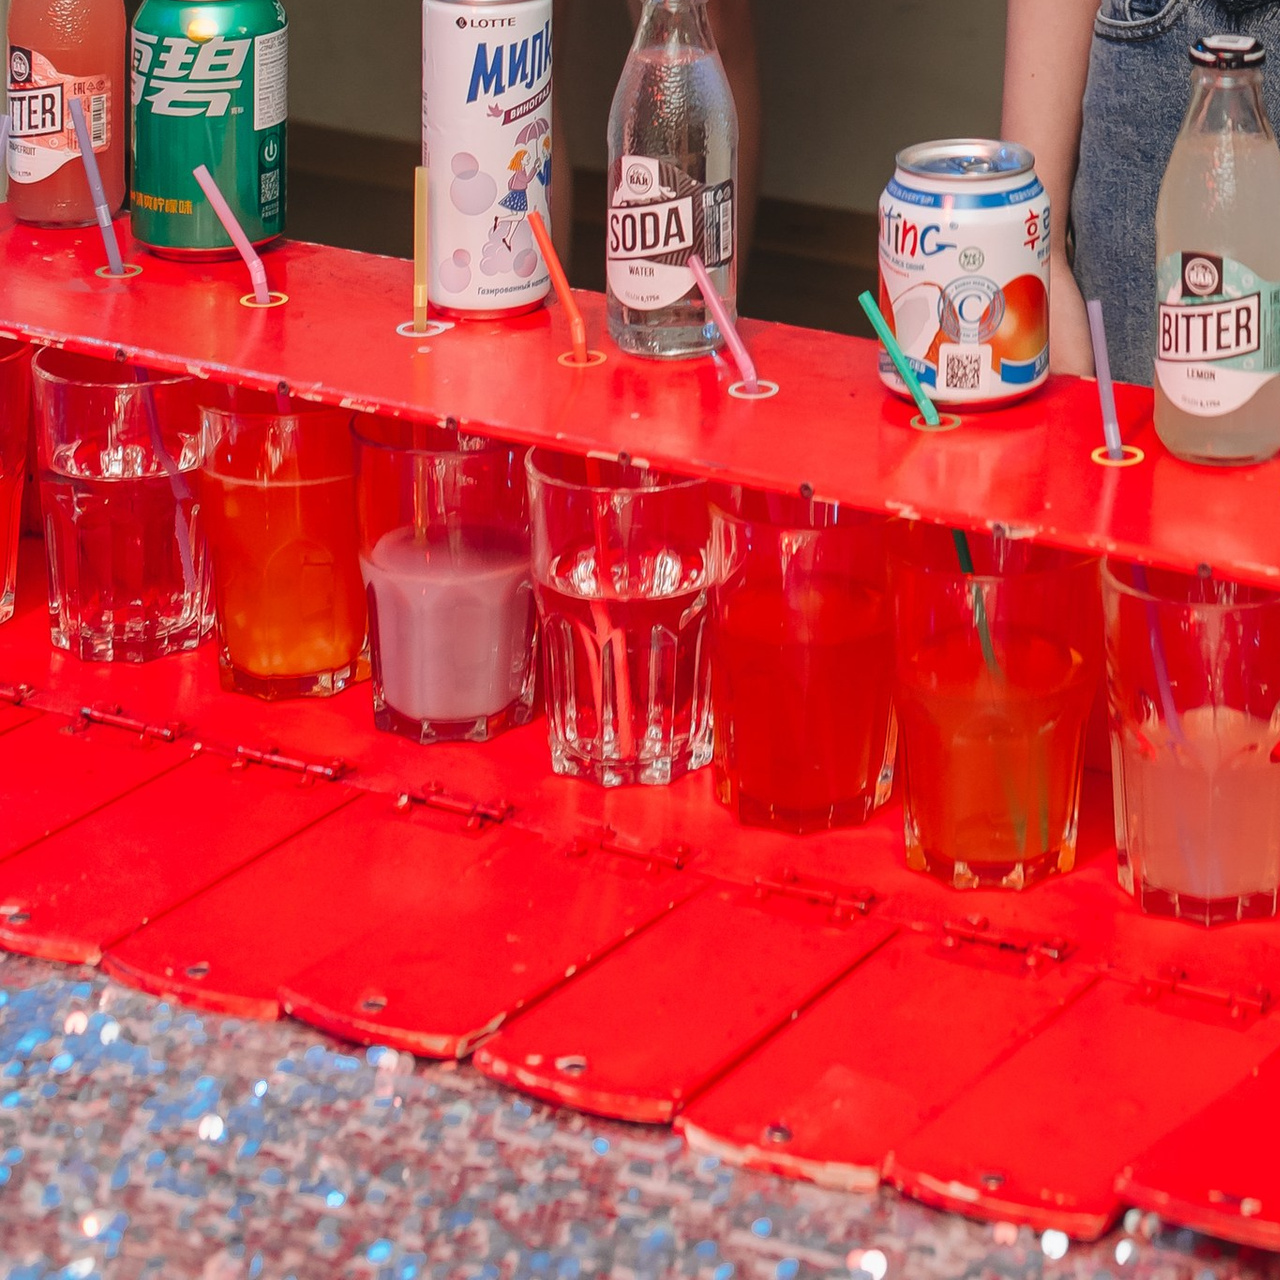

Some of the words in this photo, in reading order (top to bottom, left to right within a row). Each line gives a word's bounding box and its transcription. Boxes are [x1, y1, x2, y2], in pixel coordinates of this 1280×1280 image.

[471, 17, 516, 28] LOTTE
[611, 206, 686, 252] SODA
[629, 266, 655, 278] WATER
[478, 281, 531, 296] Газированный
[1162, 306, 1252, 354] BITTER
[1187, 368, 1216, 381] LEMON
